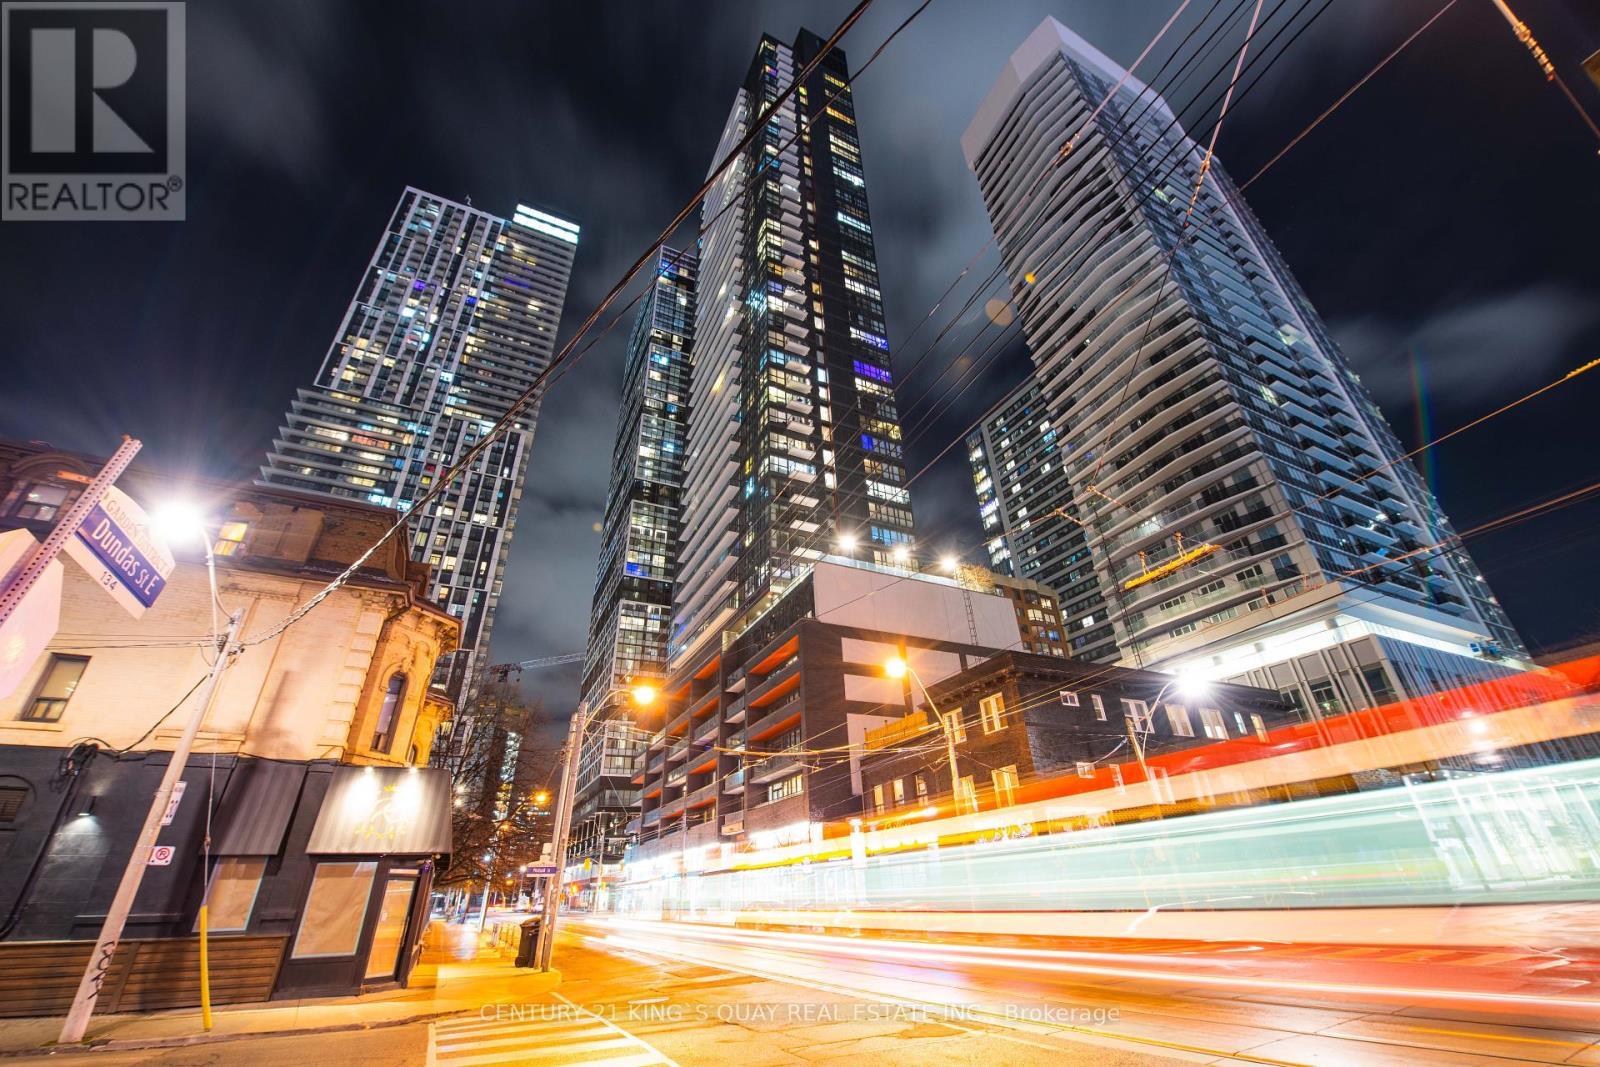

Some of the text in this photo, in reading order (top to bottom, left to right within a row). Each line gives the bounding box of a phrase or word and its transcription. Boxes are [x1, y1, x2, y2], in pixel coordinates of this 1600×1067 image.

[91, 517, 160, 596] Dundas St E
[100, 571, 118, 591] 134
